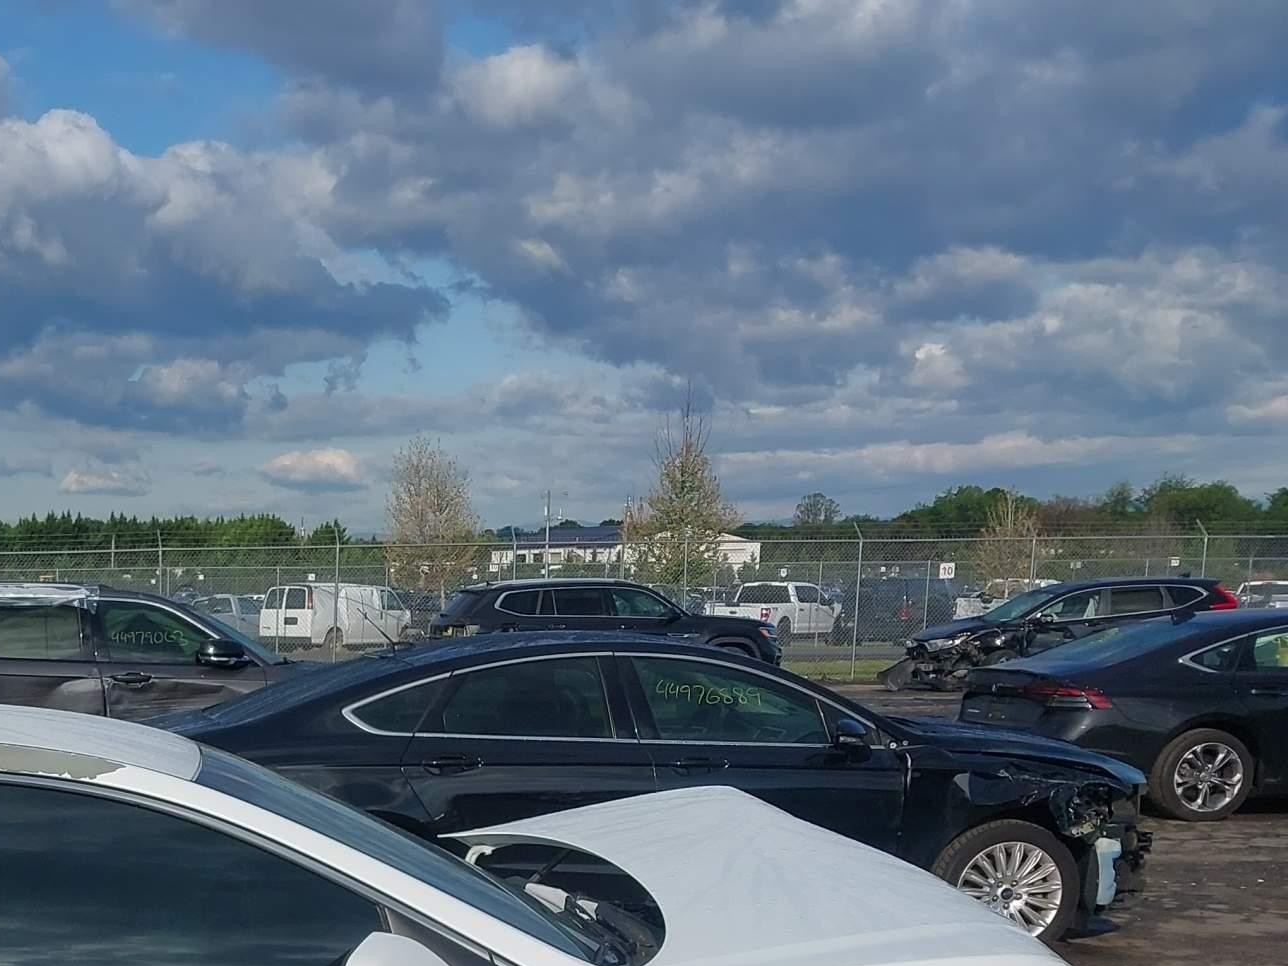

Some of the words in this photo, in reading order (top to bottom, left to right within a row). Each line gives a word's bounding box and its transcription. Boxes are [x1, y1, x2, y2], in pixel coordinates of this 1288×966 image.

[942, 566, 953, 576] 10
[112, 630, 188, 646] 44979063
[655, 679, 761, 705] 44976889
